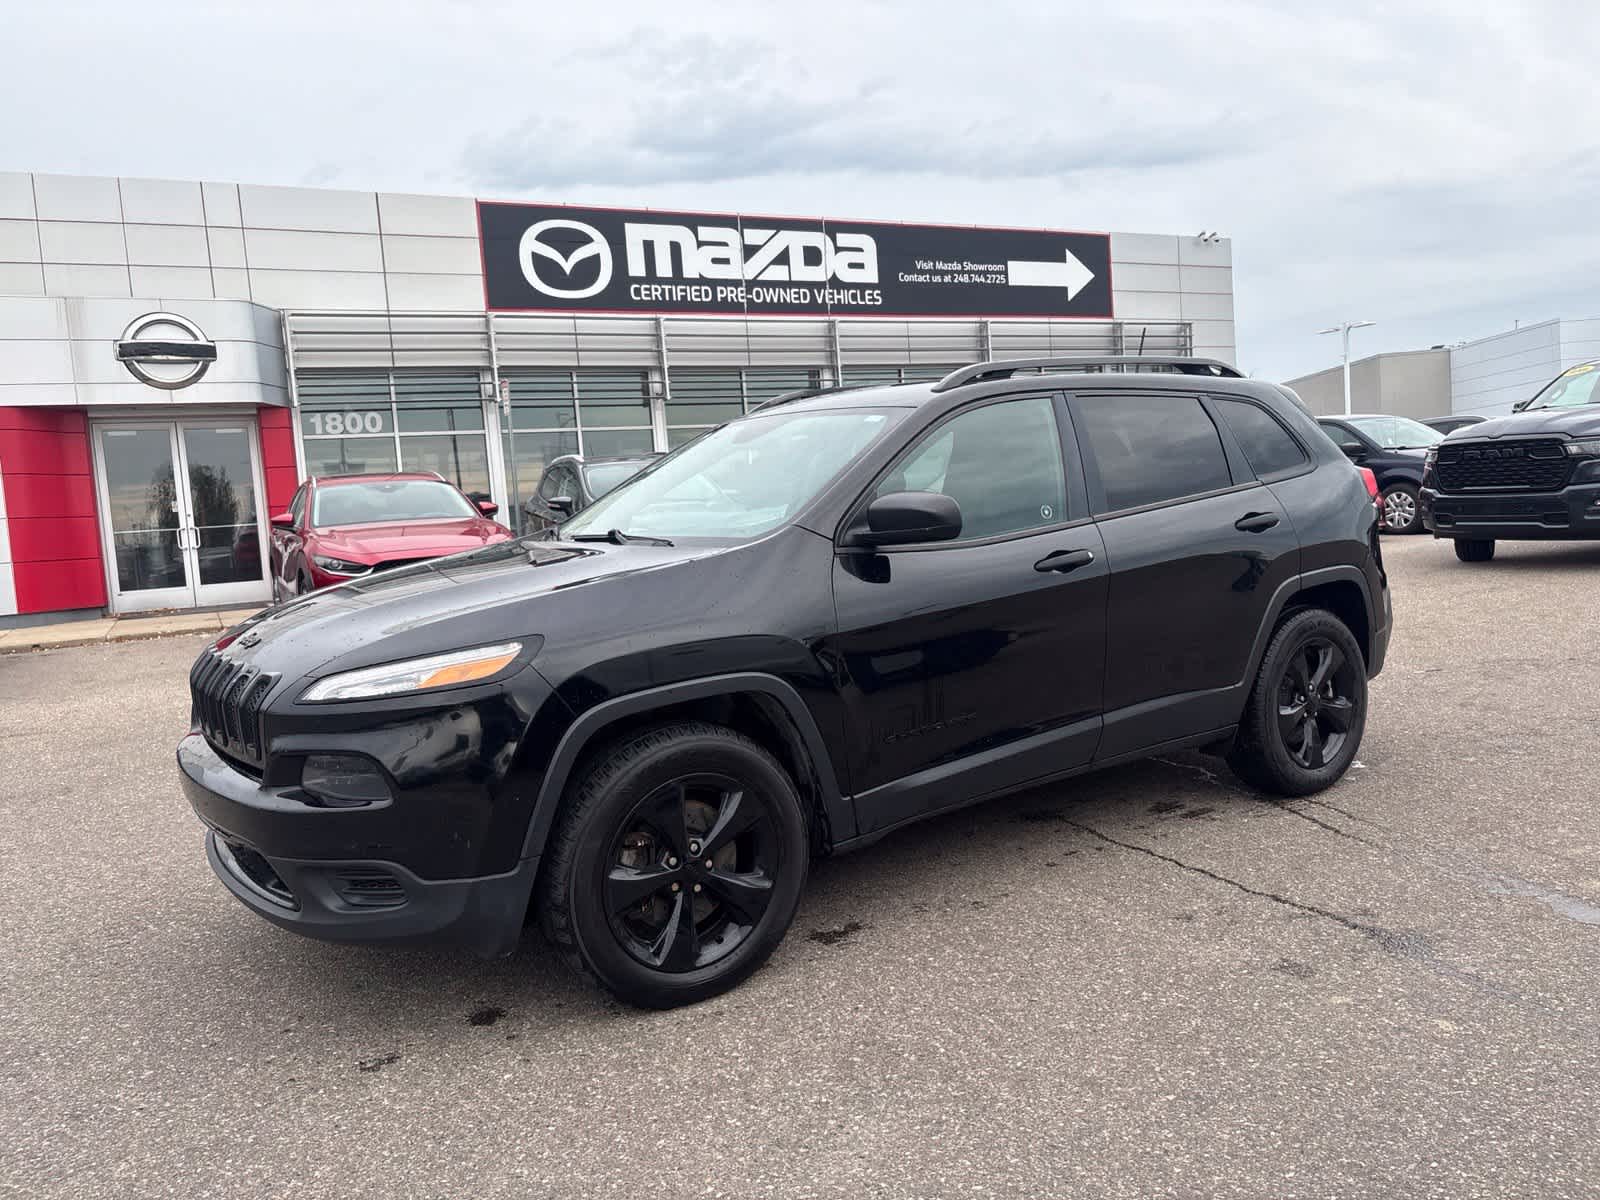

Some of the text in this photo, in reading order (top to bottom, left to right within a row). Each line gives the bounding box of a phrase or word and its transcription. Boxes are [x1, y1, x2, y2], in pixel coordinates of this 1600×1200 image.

[915, 260, 1006, 272] Visit Mazda Showroom
[898, 272, 1007, 284] Contact us at 248.744.2725
[630, 284, 883, 305] CERTIFIED PRE-OWNED VEHICLES
[309, 412, 383, 434] 1800
